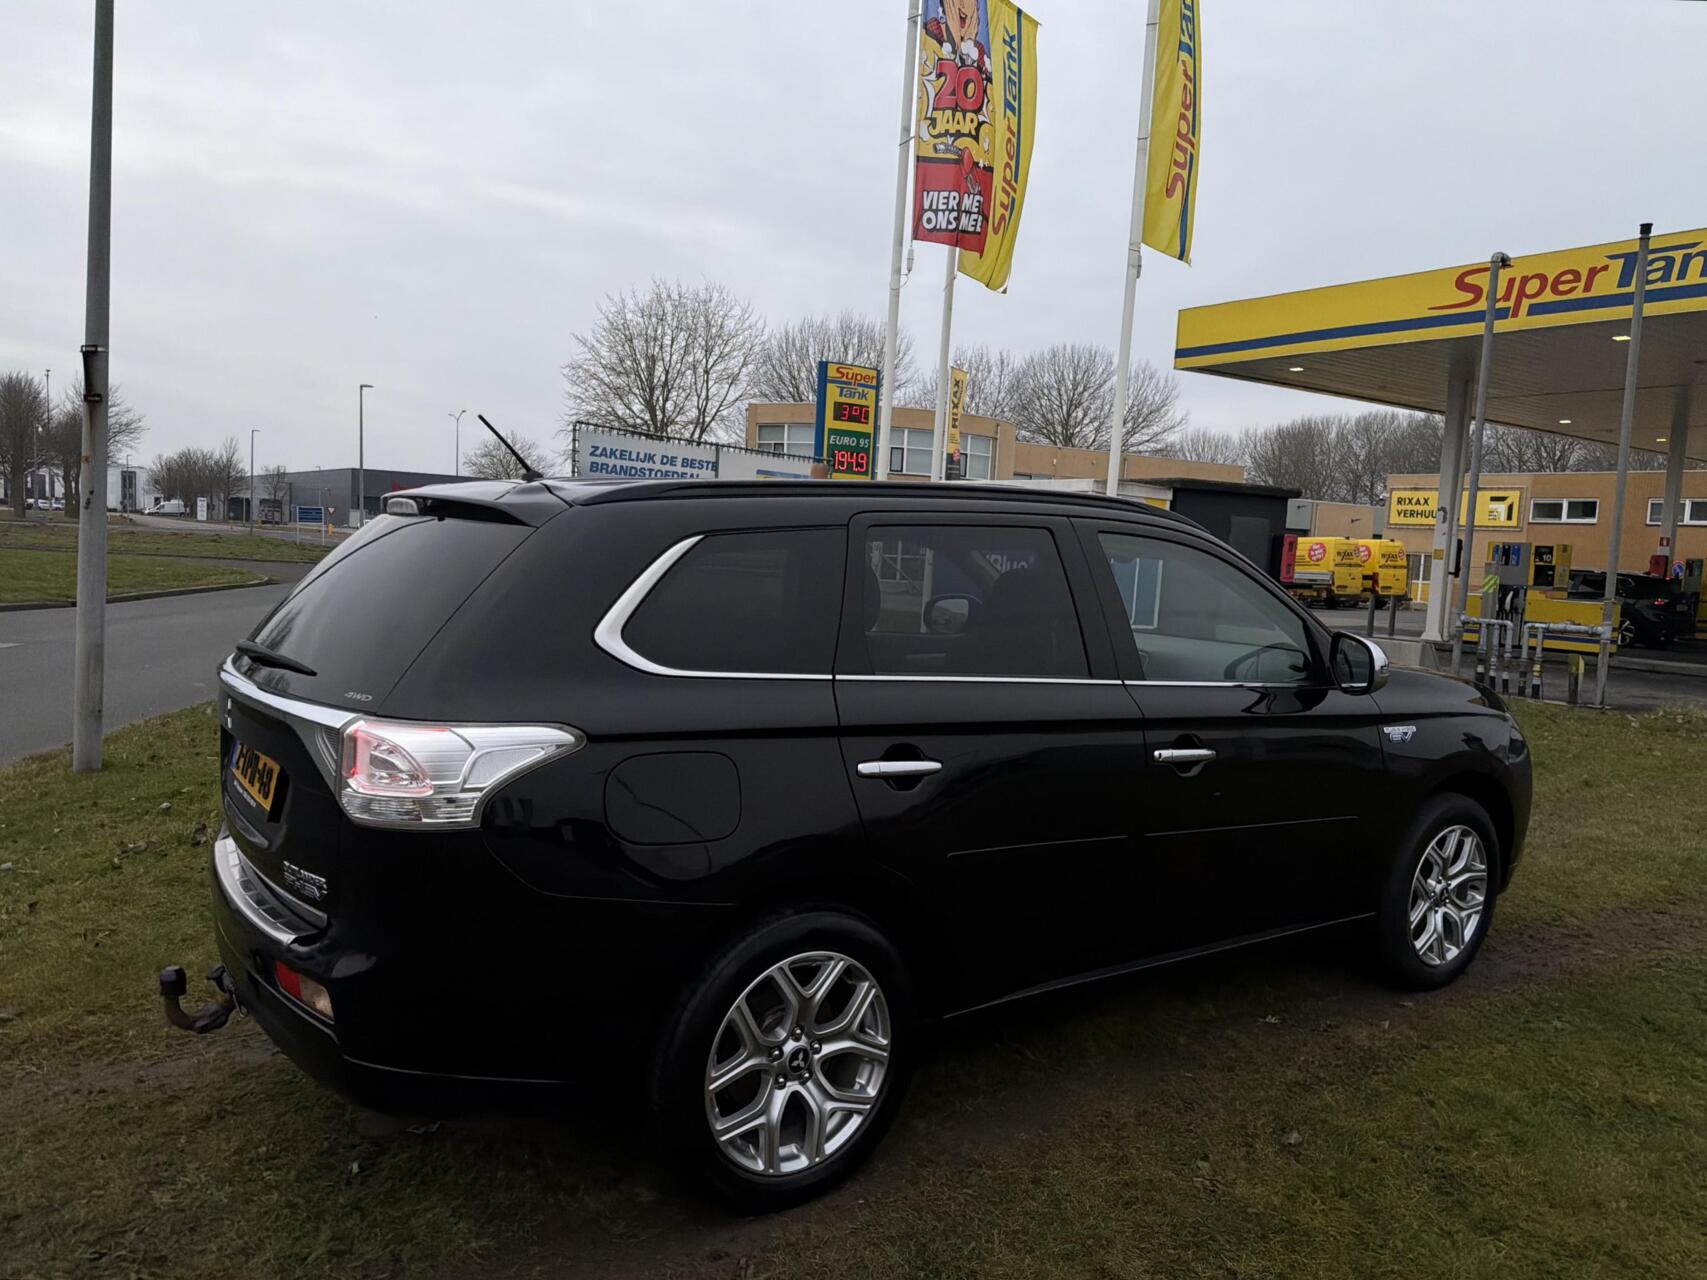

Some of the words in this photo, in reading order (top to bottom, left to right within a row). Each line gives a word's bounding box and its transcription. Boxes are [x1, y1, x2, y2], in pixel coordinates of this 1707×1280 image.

[933, 59, 984, 111] 20
[930, 110, 979, 136] JAAR
[922, 190, 959, 211] VIER
[922, 210, 957, 230] ONS
[831, 366, 876, 388] Super
[836, 385, 869, 401] Tank
[829, 435, 857, 447] EURO
[859, 438, 870, 448] 95
[589, 444, 657, 465] ZAKELIJK
[660, 454, 677, 467] DE
[680, 456, 718, 472] BESTE
[1396, 496, 1430, 506] RIXAX
[1542, 553, 1552, 562] 10
